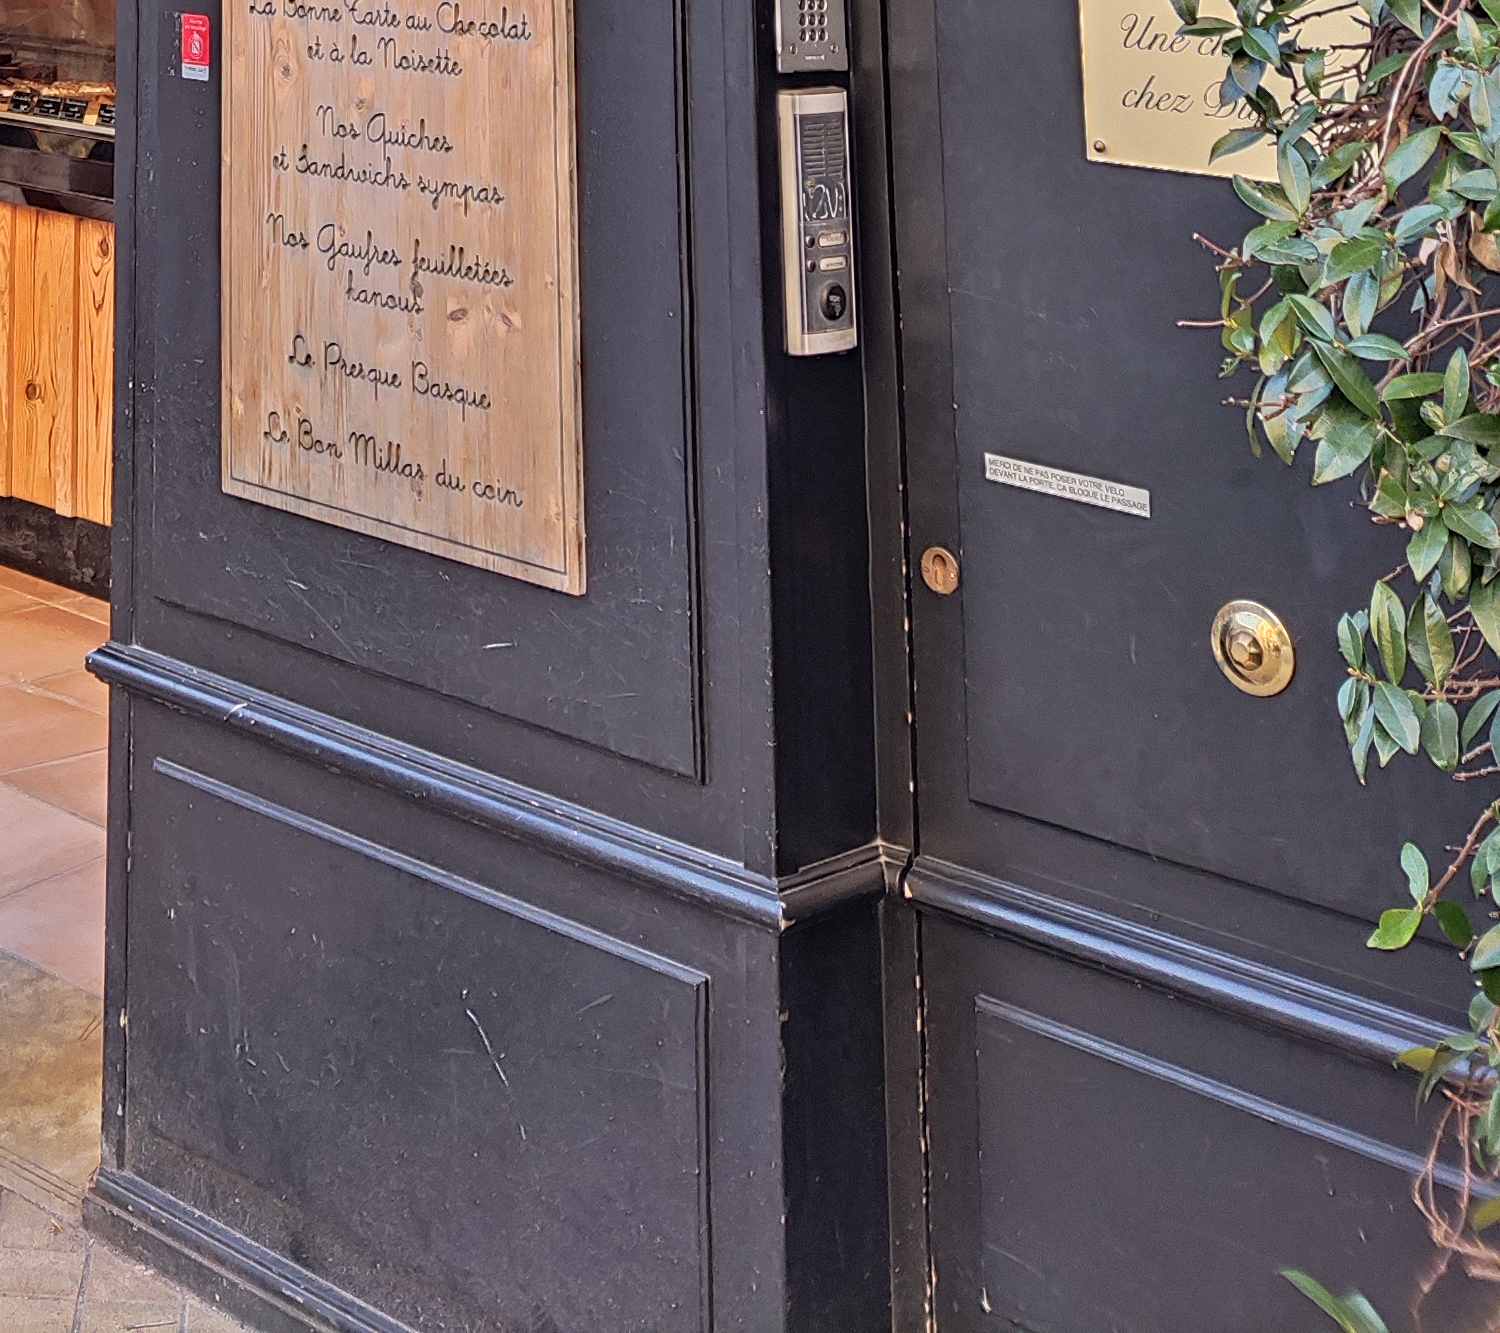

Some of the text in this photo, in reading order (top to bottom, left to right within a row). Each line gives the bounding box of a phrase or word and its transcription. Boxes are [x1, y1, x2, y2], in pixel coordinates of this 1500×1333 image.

[405, 12, 432, 33] au
[436, 1, 532, 41] Chocolat
[1119, 13, 1192, 54] Une
[307, 34, 463, 76] et à la Noisette
[1121, 74, 1194, 114] chez
[316, 104, 454, 160] Nos Quiches
[272, 144, 505, 217] et Sandwichs sympas
[266, 212, 514, 288] Nos Gaufres feuilletées
[288, 334, 492, 422] Le Presque Basque
[263, 411, 523, 509] Le Bon Millas du coin
[988, 458, 1012, 470] MERCI
[1012, 463, 1023, 473] DE
[1024, 466, 1034, 475] NE
[1035, 468, 1050, 479] PAS
[1051, 472, 1077, 486] POSER
[1077, 478, 1104, 492] VOTRE
[989, 466, 1018, 480] DEVANT
[1018, 472, 1029, 484] LA
[1068, 484, 1099, 500] BLOQUE
[1100, 492, 1110, 503] LE
[1111, 496, 1148, 512] PASSAGE
